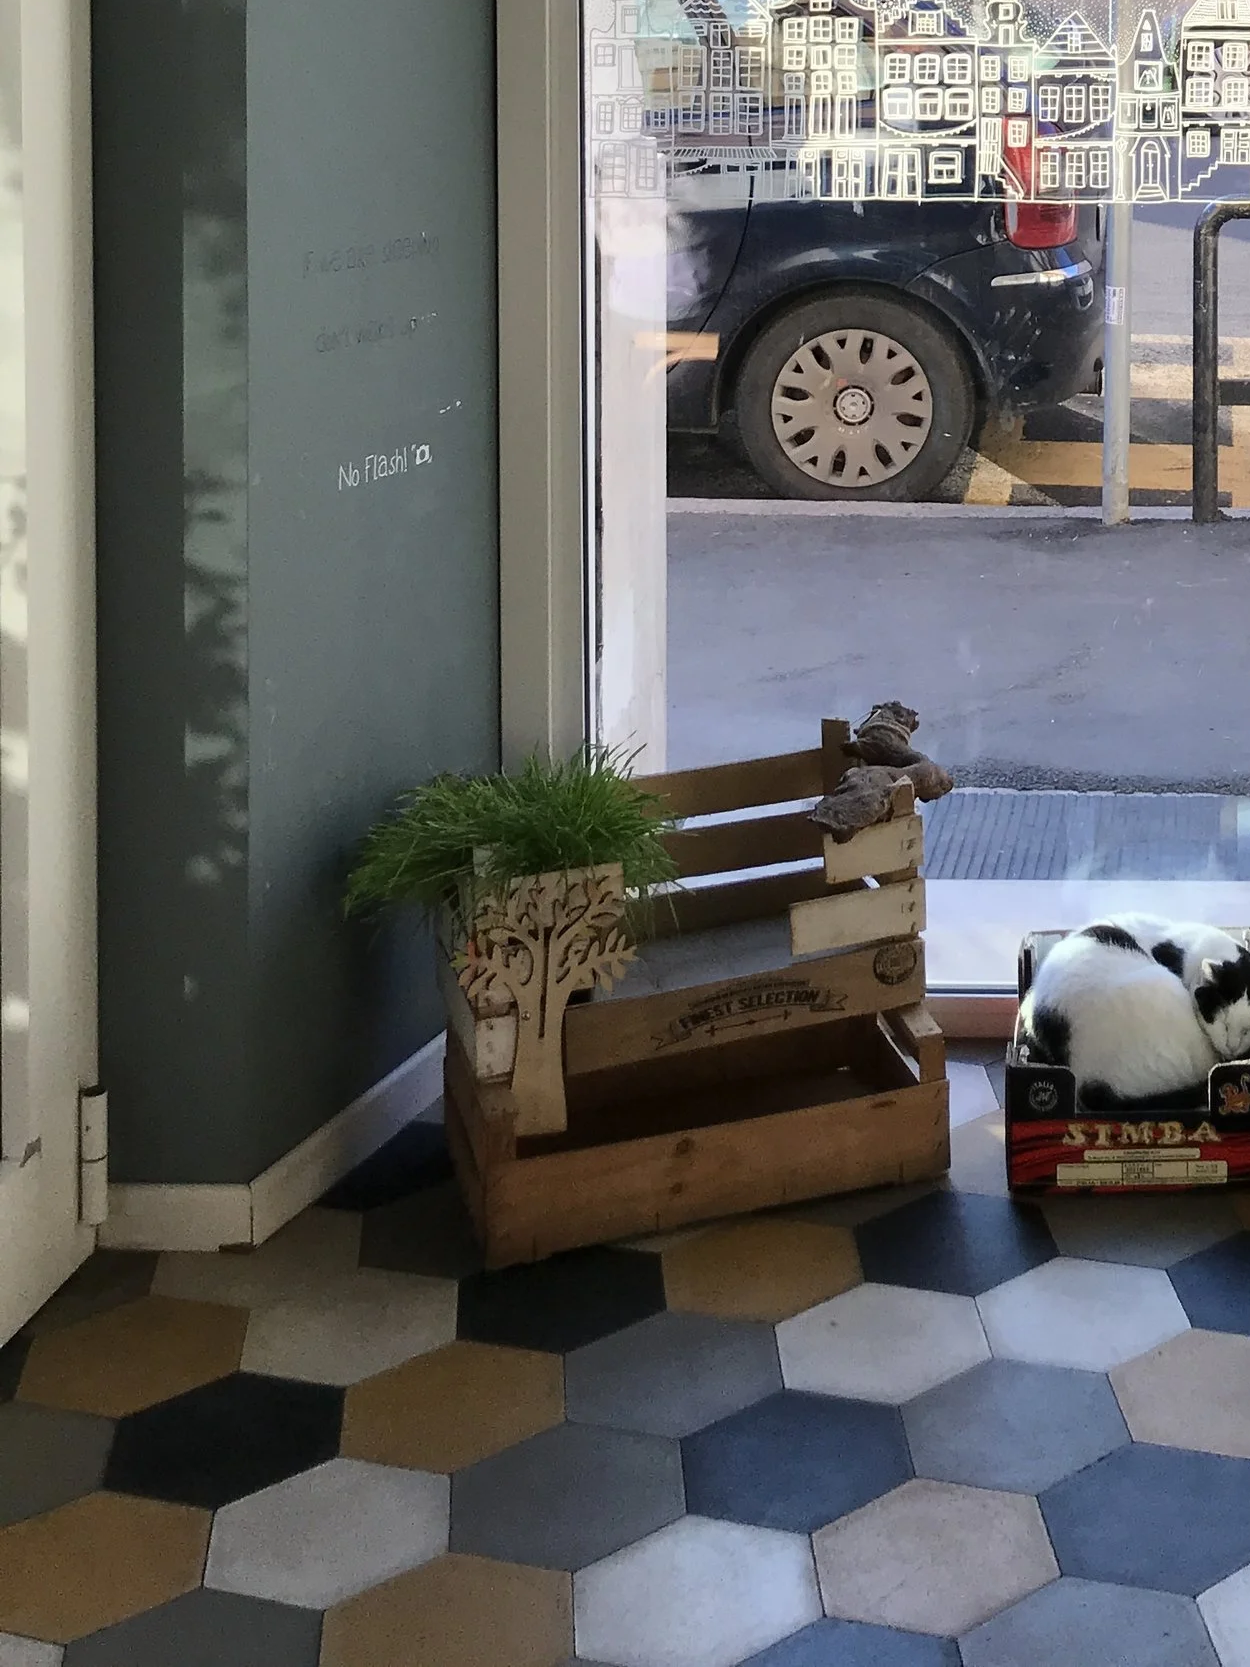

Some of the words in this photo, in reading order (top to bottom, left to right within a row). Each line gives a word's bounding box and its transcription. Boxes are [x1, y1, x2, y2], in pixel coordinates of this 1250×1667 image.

[338, 462, 361, 491] No
[364, 447, 409, 482] Flash!
[737, 990, 821, 1010] SELECTION
[1062, 1120, 1222, 1148] SIMBA
